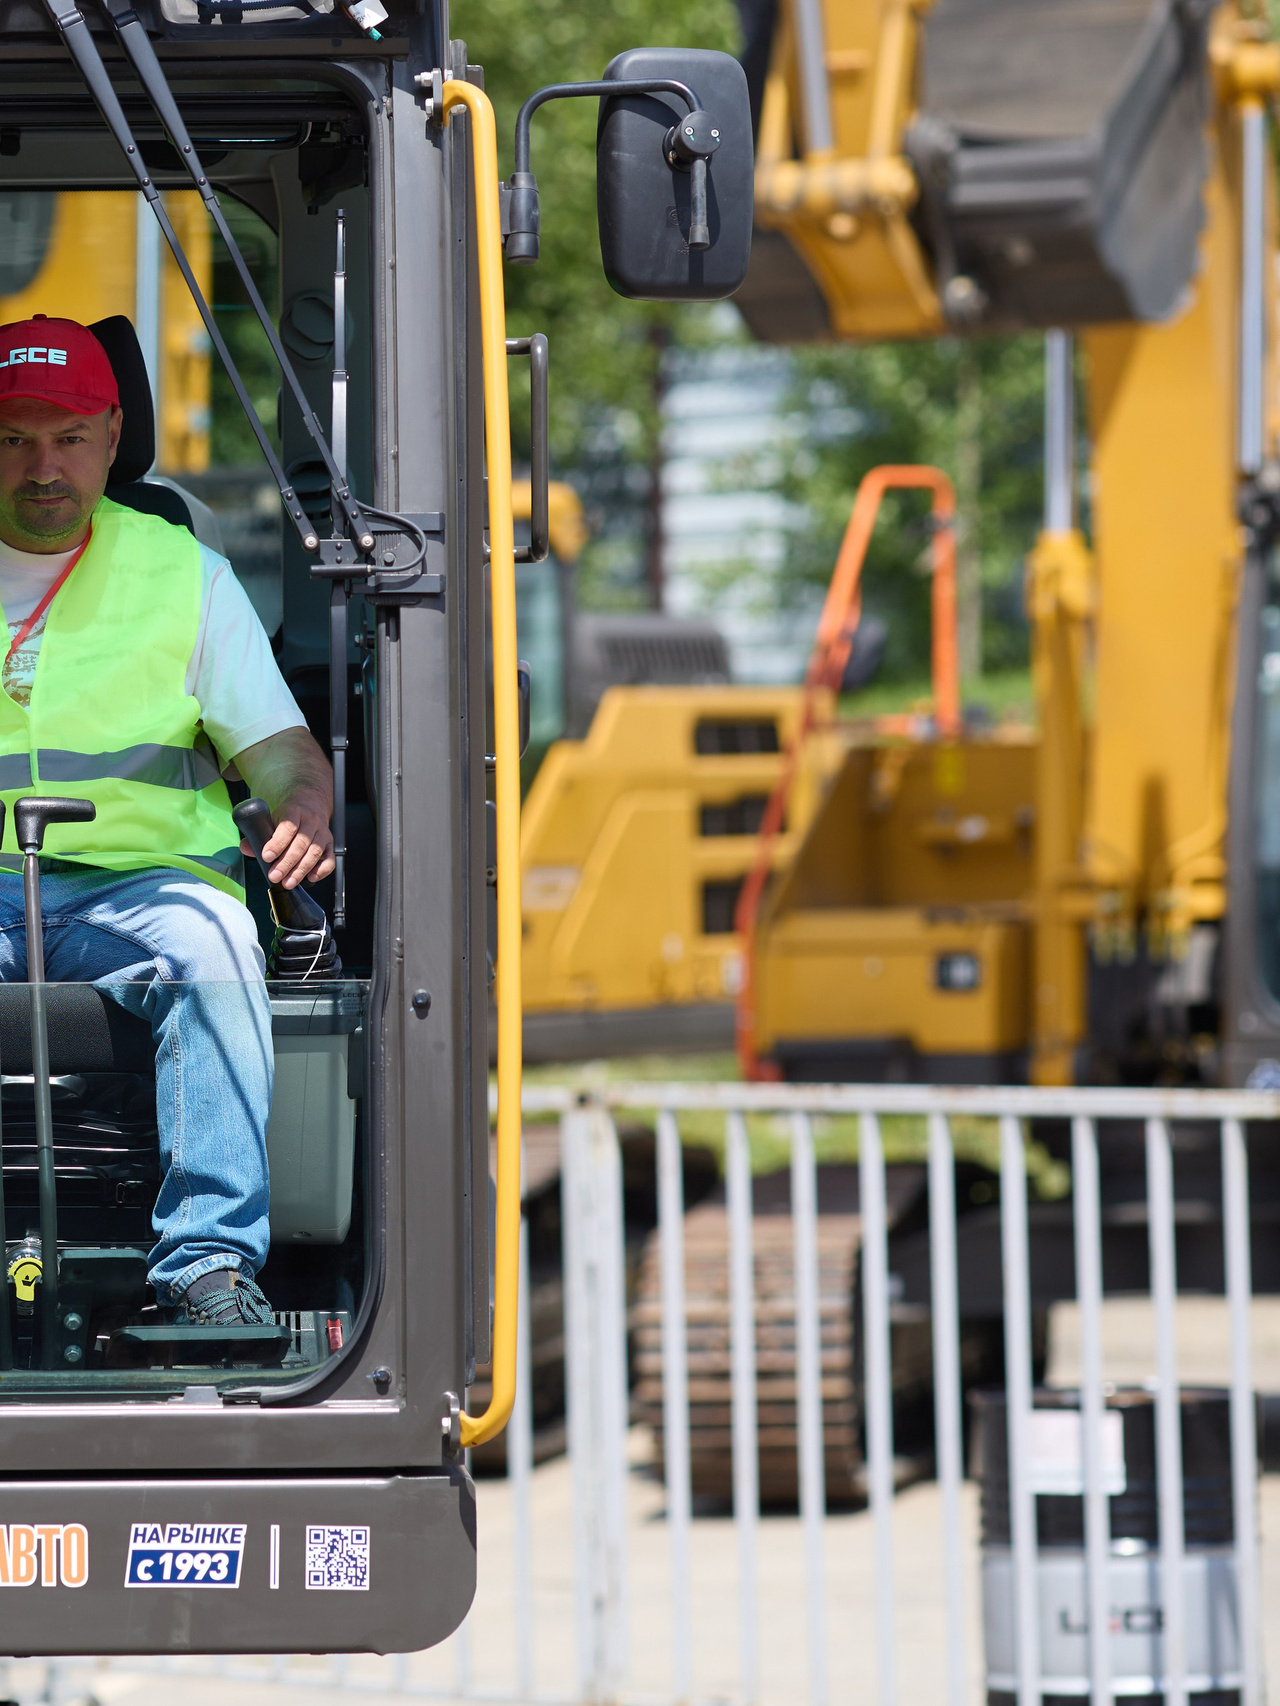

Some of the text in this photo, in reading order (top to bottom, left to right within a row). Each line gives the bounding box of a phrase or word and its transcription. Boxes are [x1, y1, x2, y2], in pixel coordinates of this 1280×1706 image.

[132, 1527, 244, 1544] НА РЫНКЕ
[158, 1551, 230, 1581] 1993
